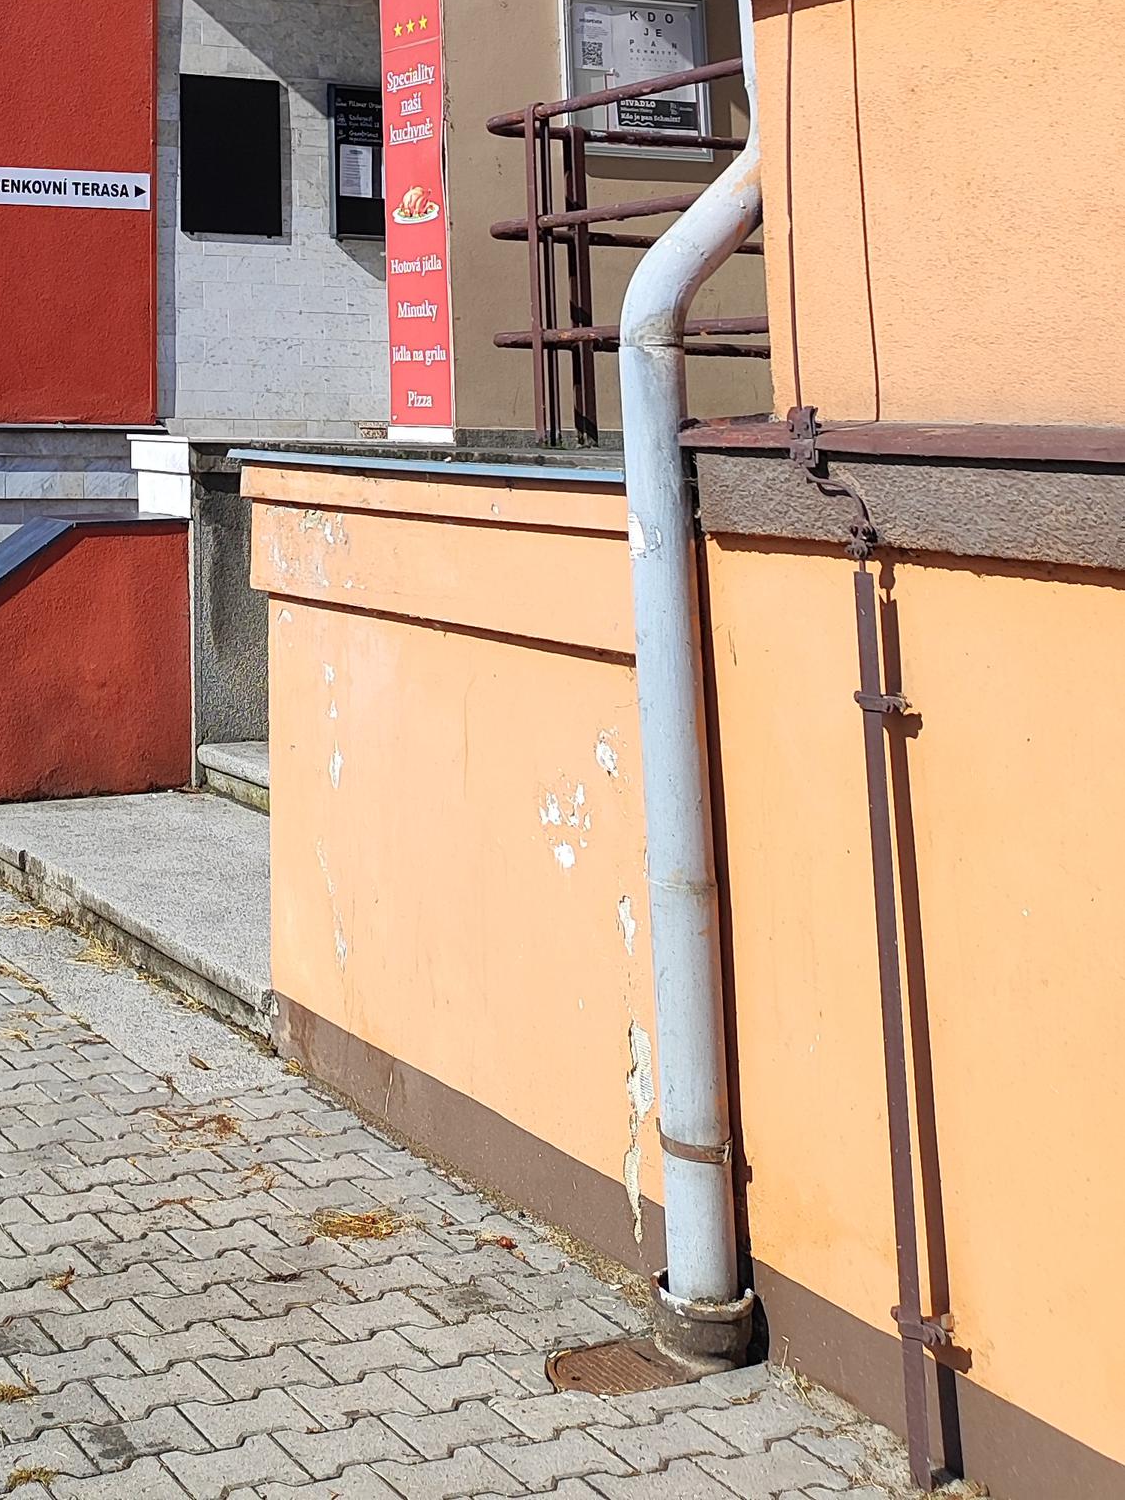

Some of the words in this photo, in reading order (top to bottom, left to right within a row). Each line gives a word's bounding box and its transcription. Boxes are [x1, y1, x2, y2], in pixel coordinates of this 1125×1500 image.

[387, 63, 435, 92] Speciality
[400, 92, 422, 113] naší
[389, 117, 433, 143] kuchyně:
[72, 182, 130, 199] TERASA
[391, 255, 421, 274] Hotová
[421, 254, 442, 276] jídla
[397, 300, 438, 321] Minutky
[392, 345, 412, 364] Jídla
[413, 351, 424, 361] na
[425, 346, 446, 365] grilu
[407, 390, 433, 407] Pizza
